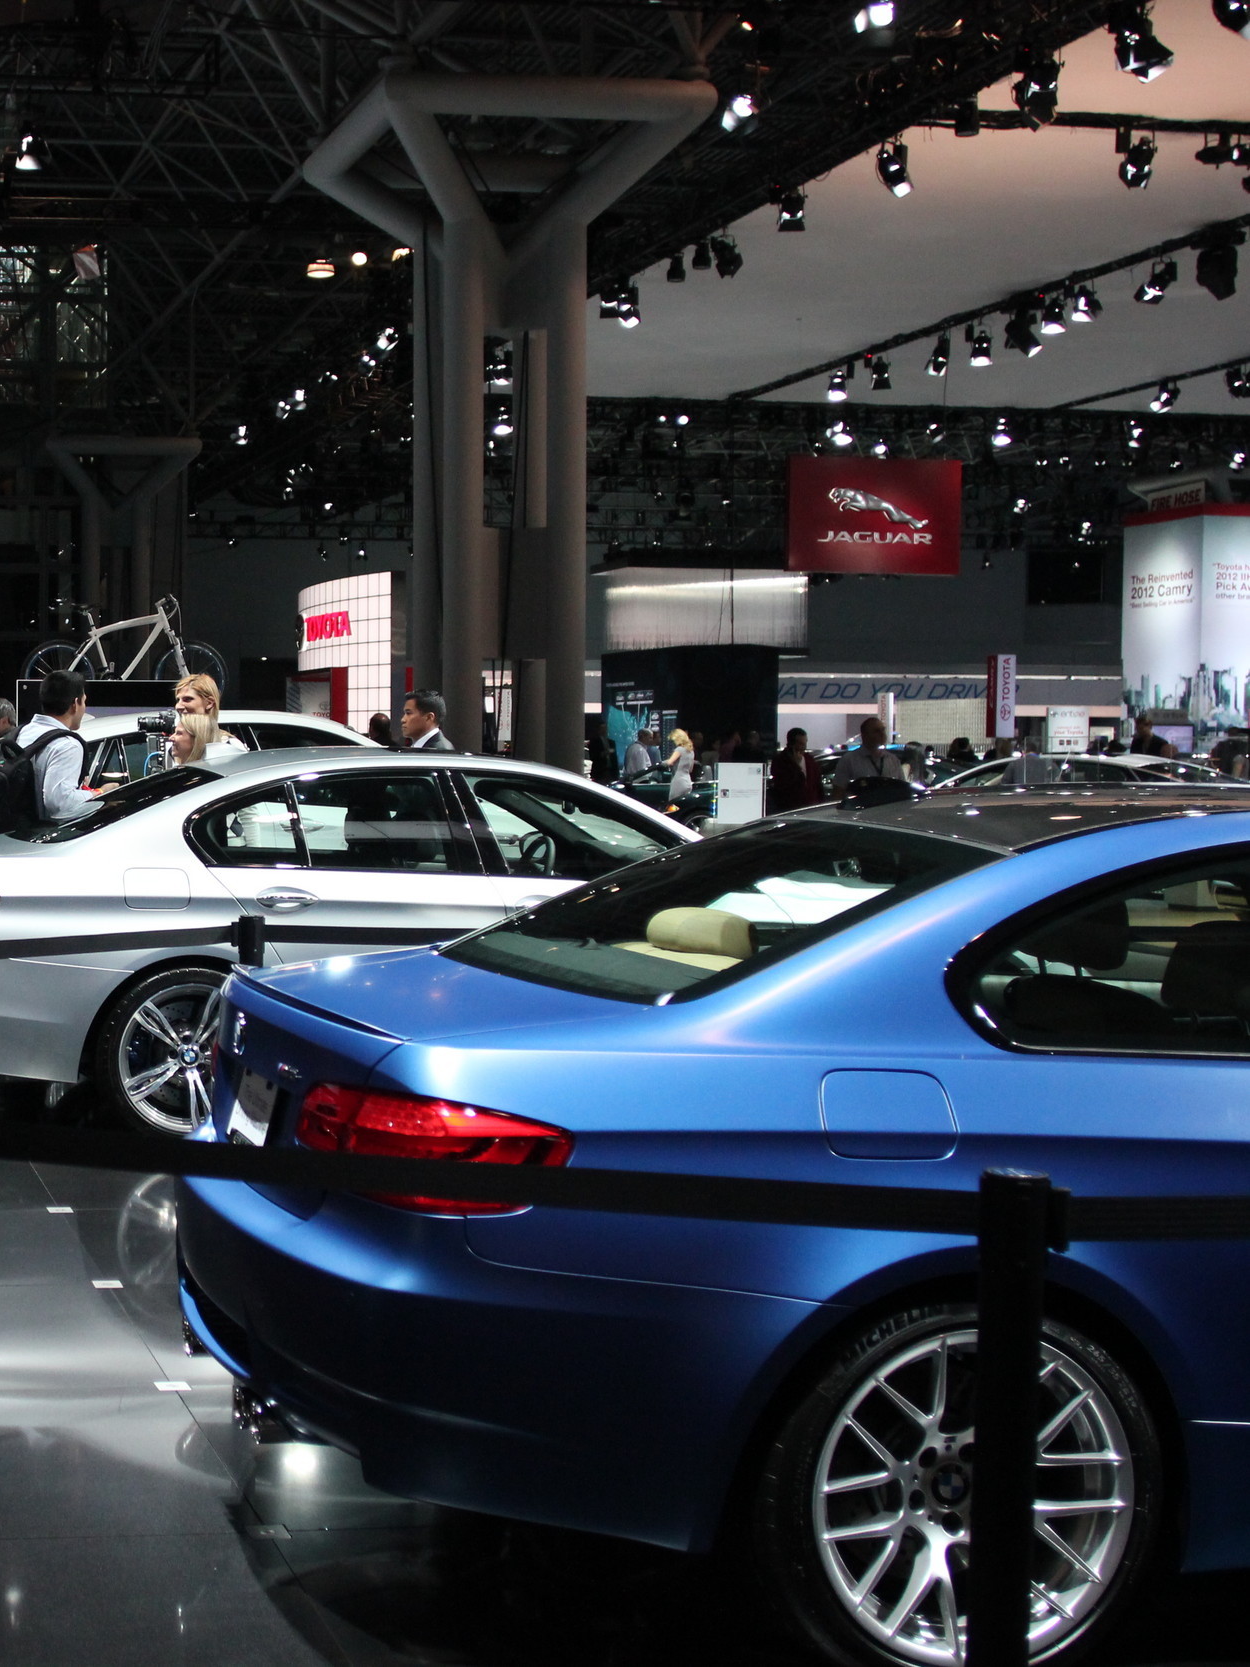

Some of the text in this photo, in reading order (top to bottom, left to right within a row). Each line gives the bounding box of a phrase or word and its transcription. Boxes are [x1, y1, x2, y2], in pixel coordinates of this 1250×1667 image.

[1151, 488, 1202, 511] FIRE HOSE
[817, 530, 933, 545] JAGUAR
[1131, 568, 1194, 585] The Reinvented
[1216, 571, 1238, 581] 2012
[1131, 584, 1193, 600] 2012 Camry
[1216, 581, 1237, 591] Pick
[1215, 592, 1235, 600] other
[304, 610, 352, 642] TOYOTA
[1002, 657, 1012, 702] TOYOTA
[777, 682, 818, 699] AT
[819, 682, 861, 700] DO
[870, 682, 925, 700] YOU
[312, 711, 331, 719] TOYO
